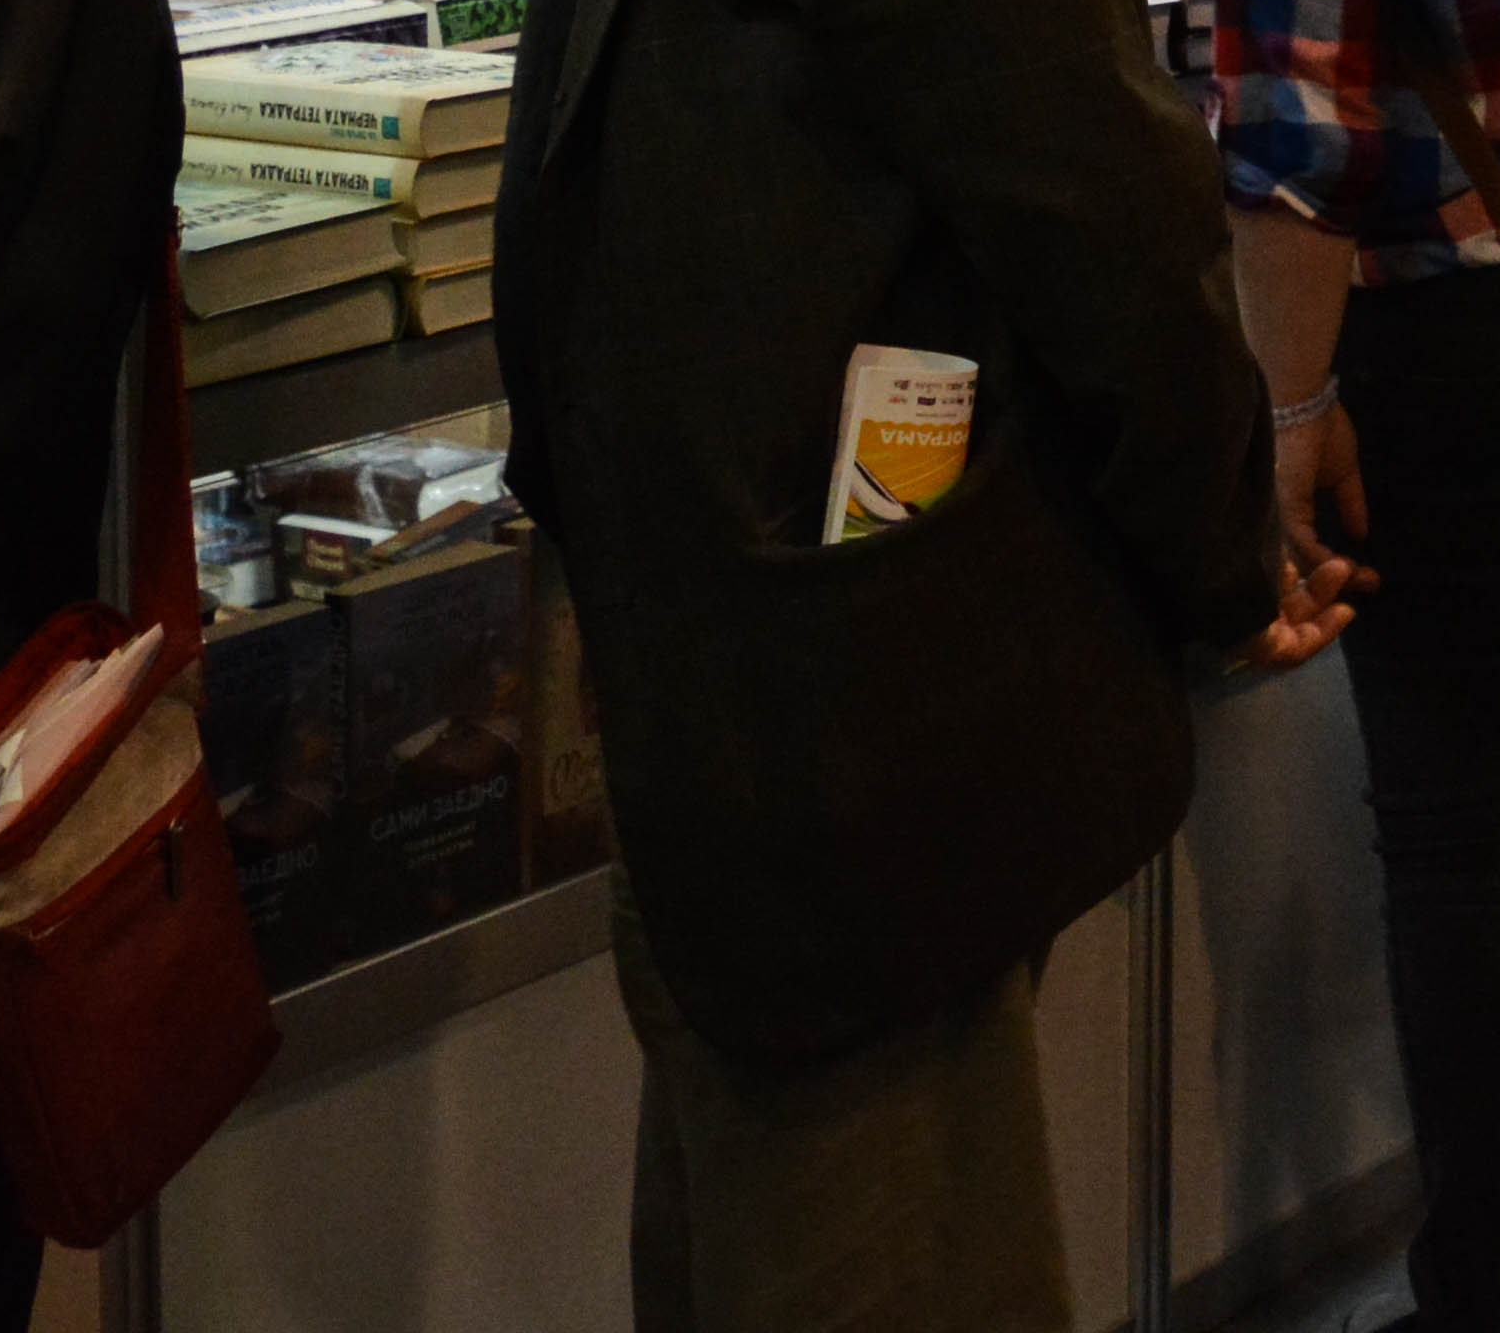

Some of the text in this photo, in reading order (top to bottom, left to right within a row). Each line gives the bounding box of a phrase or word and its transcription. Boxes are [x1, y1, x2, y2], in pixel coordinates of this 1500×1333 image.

[258, 100, 321, 126] ТЕТРАДКА
[325, 107, 378, 131] ЧЕРНАТА
[250, 161, 313, 187] ТЕТРАДКА
[317, 168, 370, 192] ЧЕРНАТА
[879, 427, 970, 447] ОГРАМА
[369, 773, 510, 844] САМИ ЗАЕДНО
